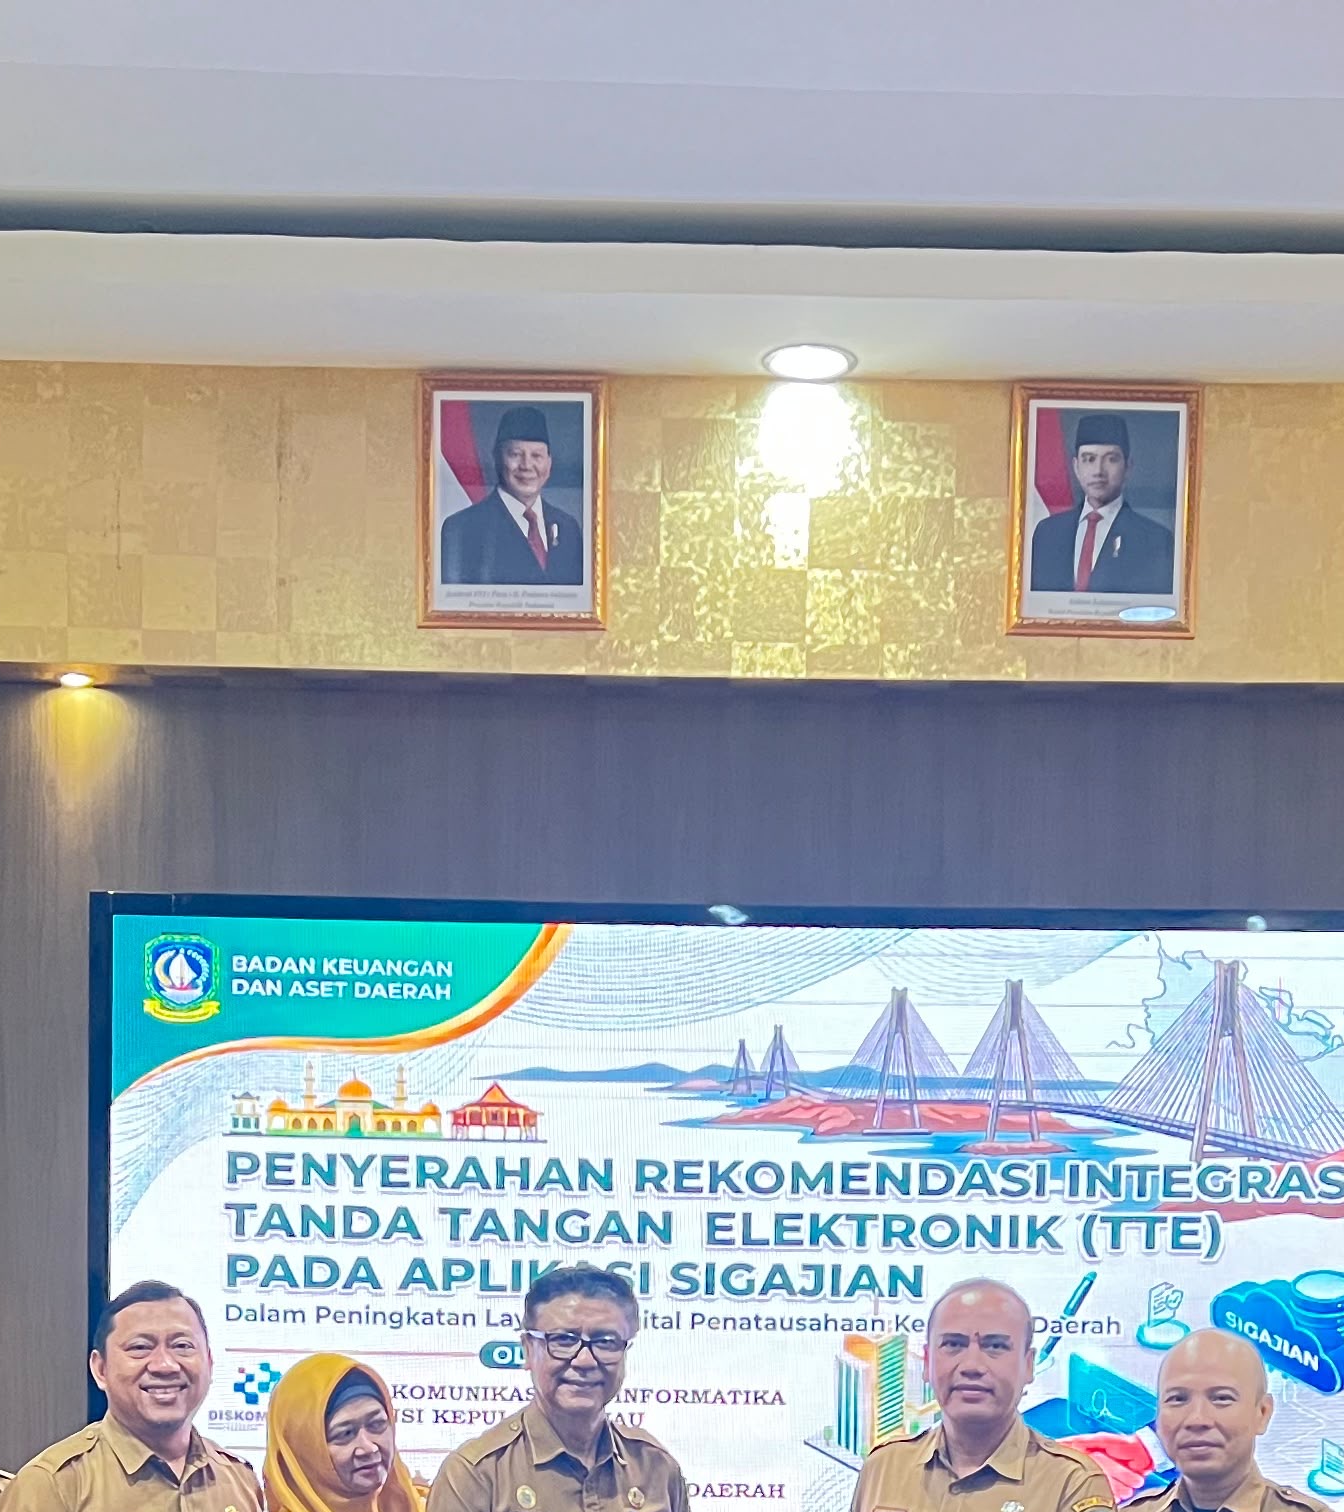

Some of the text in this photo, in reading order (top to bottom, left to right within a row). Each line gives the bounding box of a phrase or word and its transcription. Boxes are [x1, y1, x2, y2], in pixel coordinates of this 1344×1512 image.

[232, 955, 453, 978] BADAN KEUANGAN
[231, 978, 452, 1001] DAN ASET DAERAH
[226, 1150, 614, 1193] PENYERAHAN
[635, 1158, 1046, 1199] REKOMENDASI
[225, 1203, 1224, 1261] TANDA TANGAN ELEKTRONIK (TTE)
[226, 1254, 382, 1290] PADA
[669, 1262, 924, 1300] SIGAJIAN
[225, 1304, 306, 1325] Dalam
[316, 1306, 476, 1329] Peningkatan
[691, 1313, 885, 1332] Penatausahaan
[1031, 1316, 1120, 1335] Daerah
[492, 1345, 526, 1365] OL
[1225, 1311, 1319, 1372] SIGAJIAN
[391, 1384, 536, 1401] KOMUNIKAS
[686, 1483, 786, 1499] DAERAH
